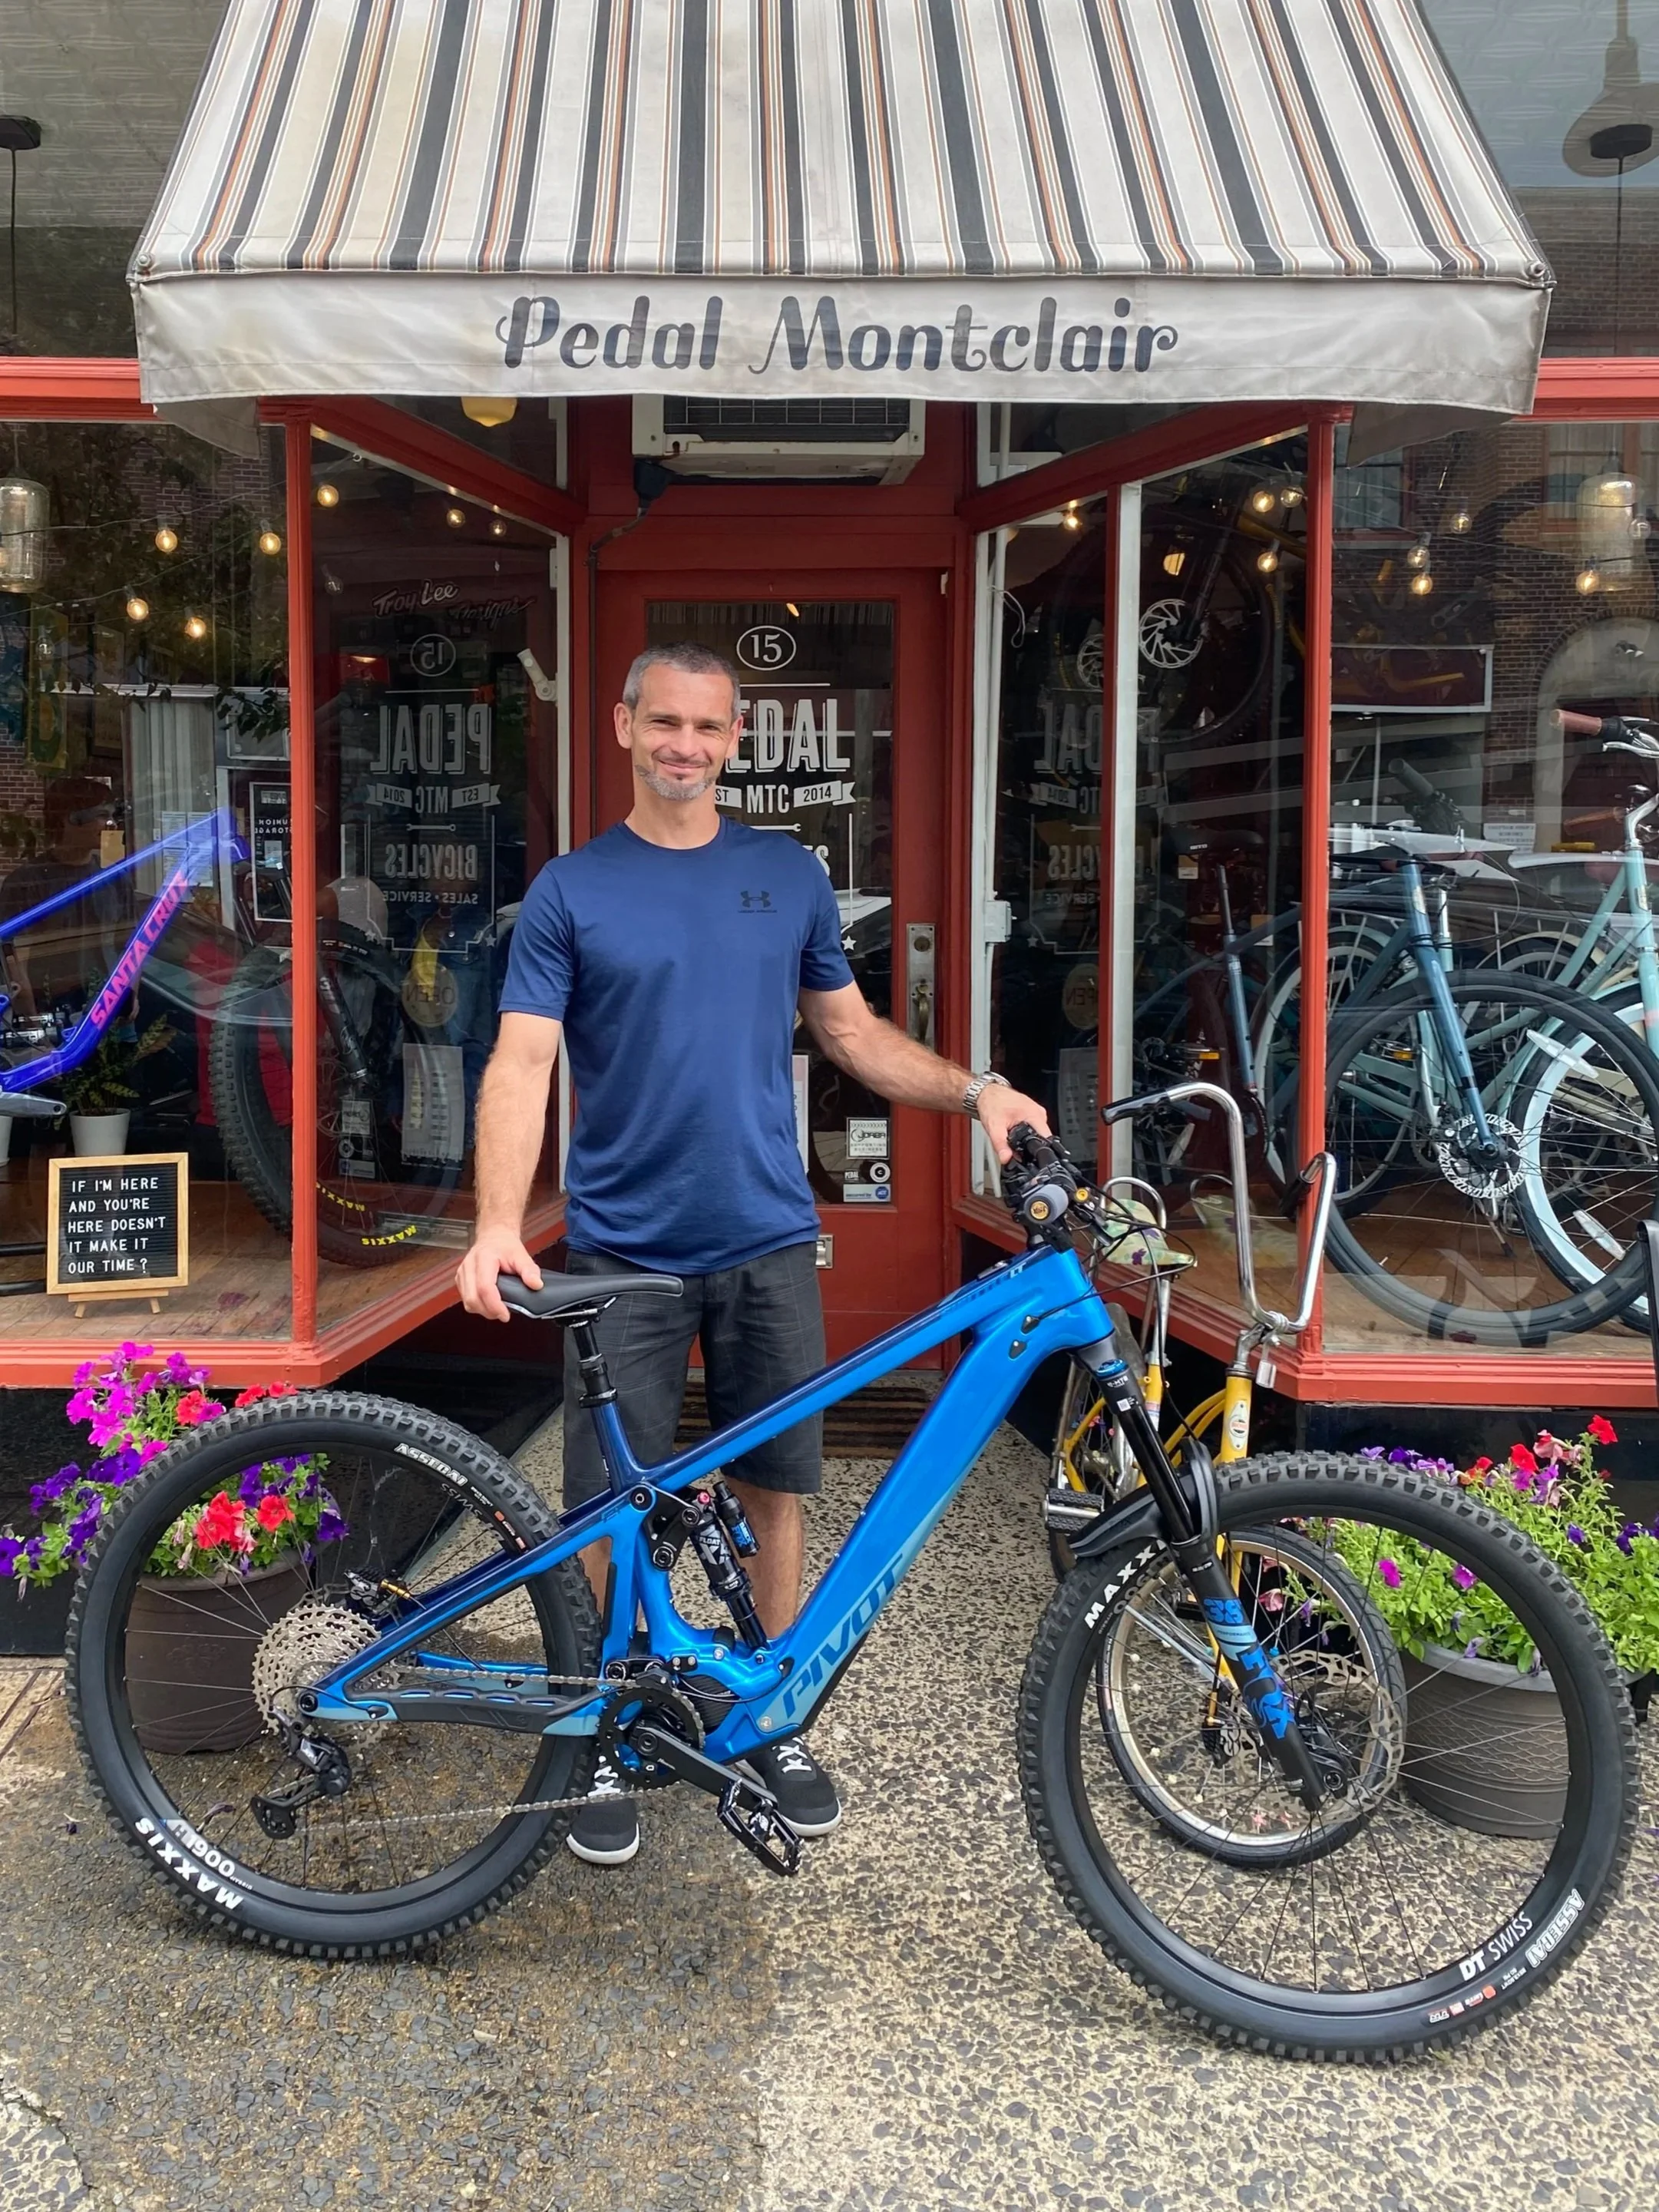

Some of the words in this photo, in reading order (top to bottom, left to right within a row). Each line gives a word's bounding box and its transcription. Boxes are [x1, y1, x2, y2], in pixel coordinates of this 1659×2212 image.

[495, 296, 723, 371] Pedal
[749, 296, 1178, 375] Montclair
[372, 588, 418, 619] Troy
[421, 579, 461, 607] Lee
[750, 633, 782, 663] 15
[725, 699, 851, 773] EDAL
[715, 789, 729, 802] ST
[746, 784, 789, 813] MTC
[803, 785, 831, 802] 2014
[90, 939, 151, 1030] SANTA
[71, 1180, 86, 1193] IF
[94, 1179, 112, 1192] I'M
[121, 1177, 159, 1190] HERE
[68, 1200, 96, 1213] AND
[104, 1197, 150, 1212] YOU'RE
[68, 1220, 104, 1234] HERE
[111, 1216, 167, 1232] DOESN'T
[361, 1224, 418, 1246] MAXXIS
[69, 1241, 82, 1254] IT
[89, 1238, 128, 1253] MAKE
[134, 1238, 149, 1251] IT
[68, 1261, 95, 1275] OUR
[102, 1258, 135, 1272] TIME
[140, 1258, 148, 1274] ?
[1010, 1261, 1027, 1278] LT
[440, 1483, 483, 1517] SWISS
[699, 1536, 722, 1546] FLOAT
[1084, 1539, 1168, 1629] MAXXI
[782, 1552, 904, 1719] PIVOT
[1239, 1643, 1297, 1740] FOX
[134, 1817, 244, 1910] MAXXIS
[1525, 1888, 1585, 1969] ASSEGAI
[1459, 1949, 1486, 1982] DT
[1488, 1911, 1533, 1962] SWISS
